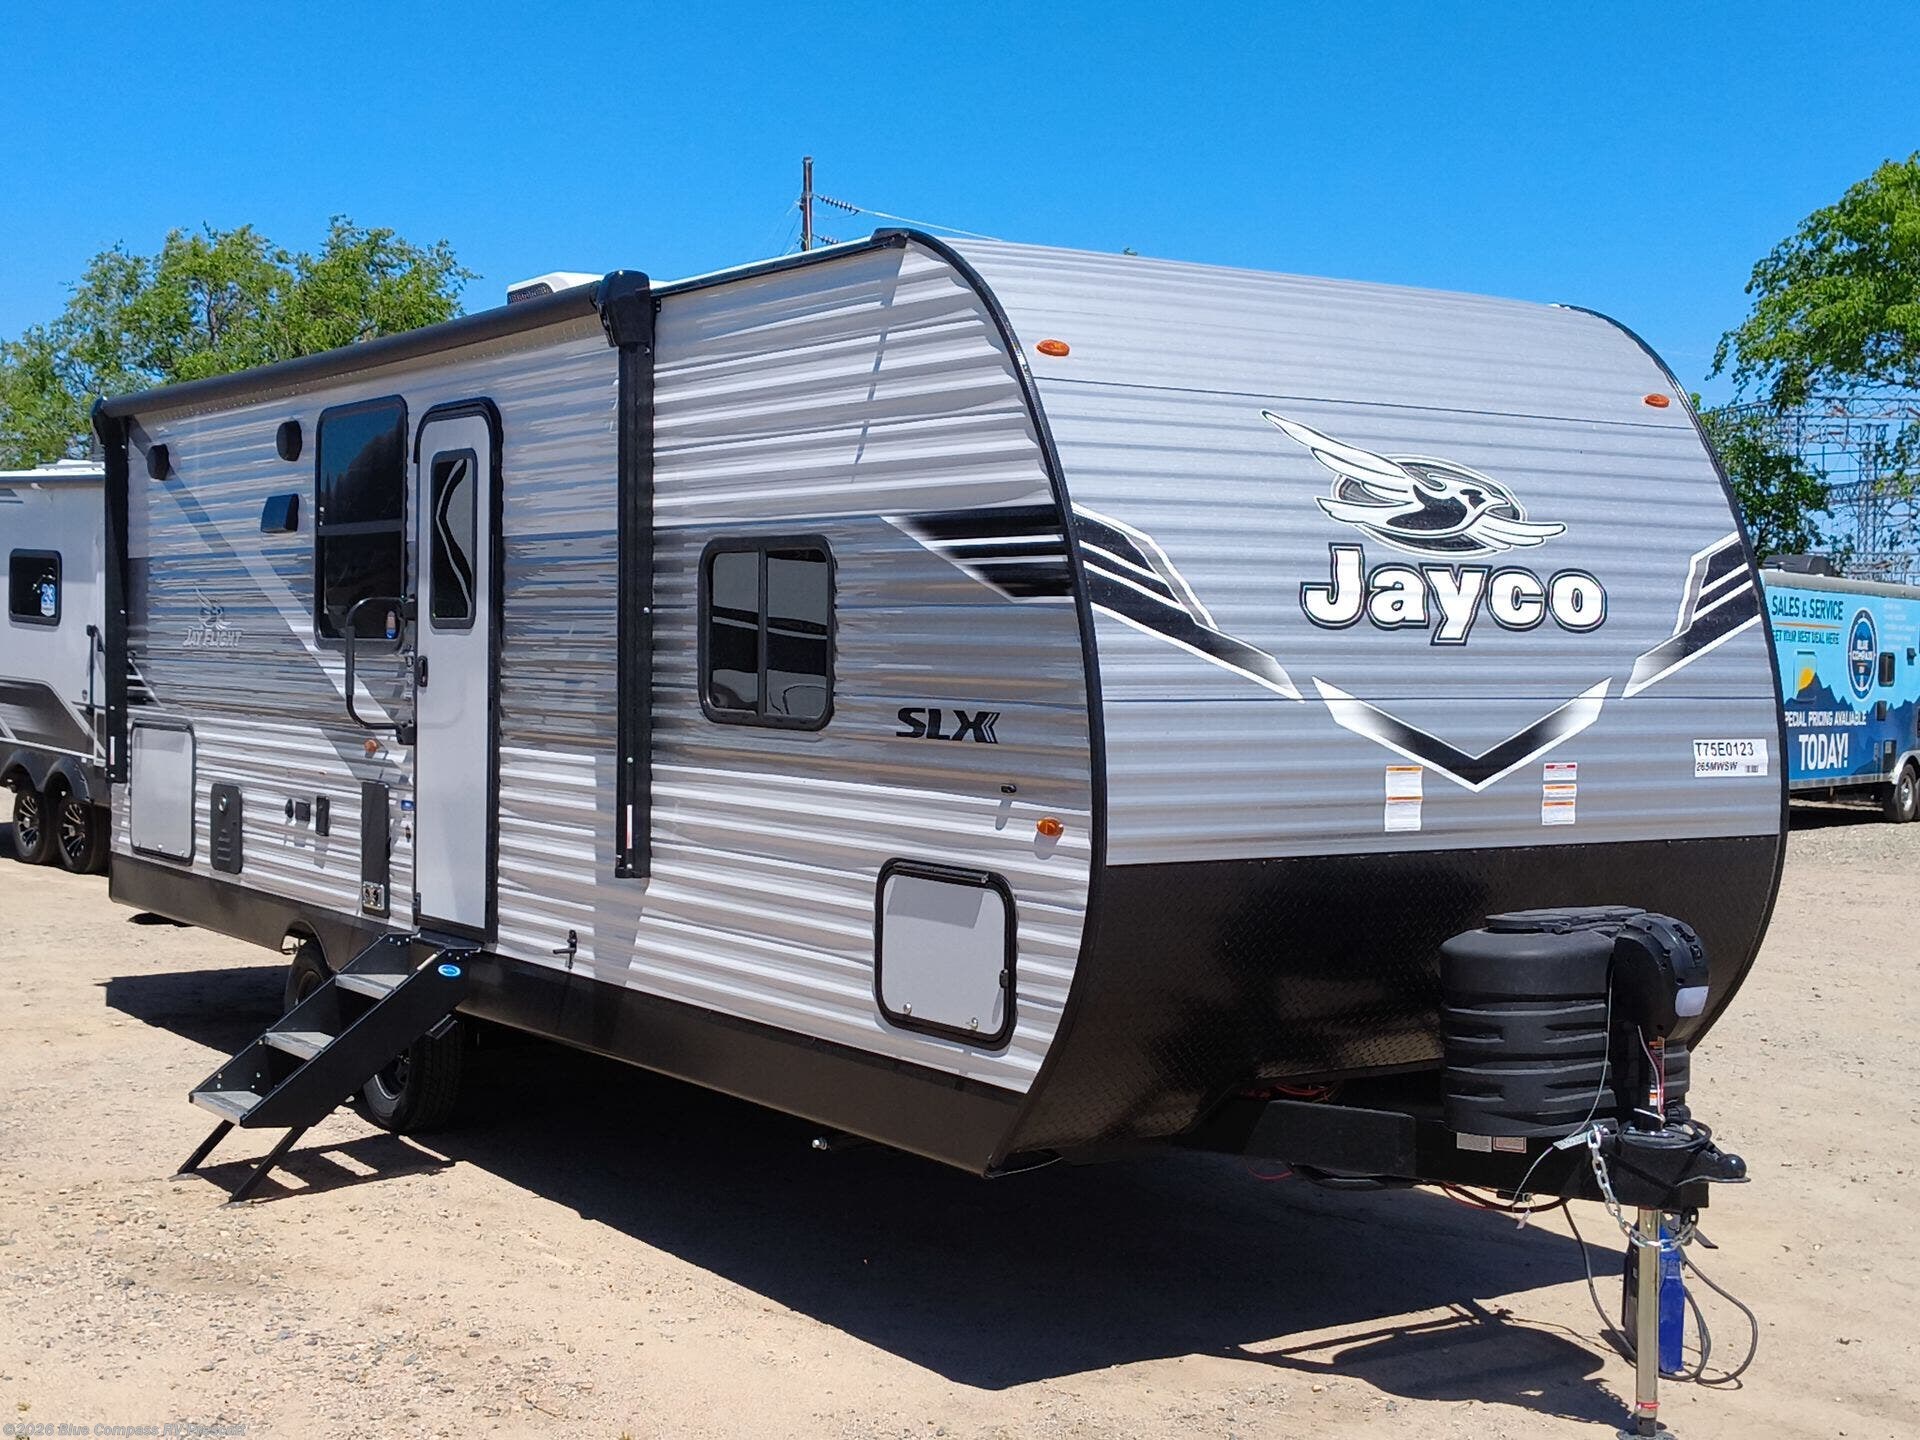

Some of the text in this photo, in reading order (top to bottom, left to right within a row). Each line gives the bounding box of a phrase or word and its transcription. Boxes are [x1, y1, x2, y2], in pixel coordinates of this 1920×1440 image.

[1300, 543, 1607, 646] Jayco
[1771, 595, 1844, 620] SALES & SERVICE
[203, 629, 242, 648] FLIGHT
[896, 707, 1000, 744] SLX
[1695, 742, 1754, 757] T75E0123
[1798, 733, 1849, 771] TODAY!
